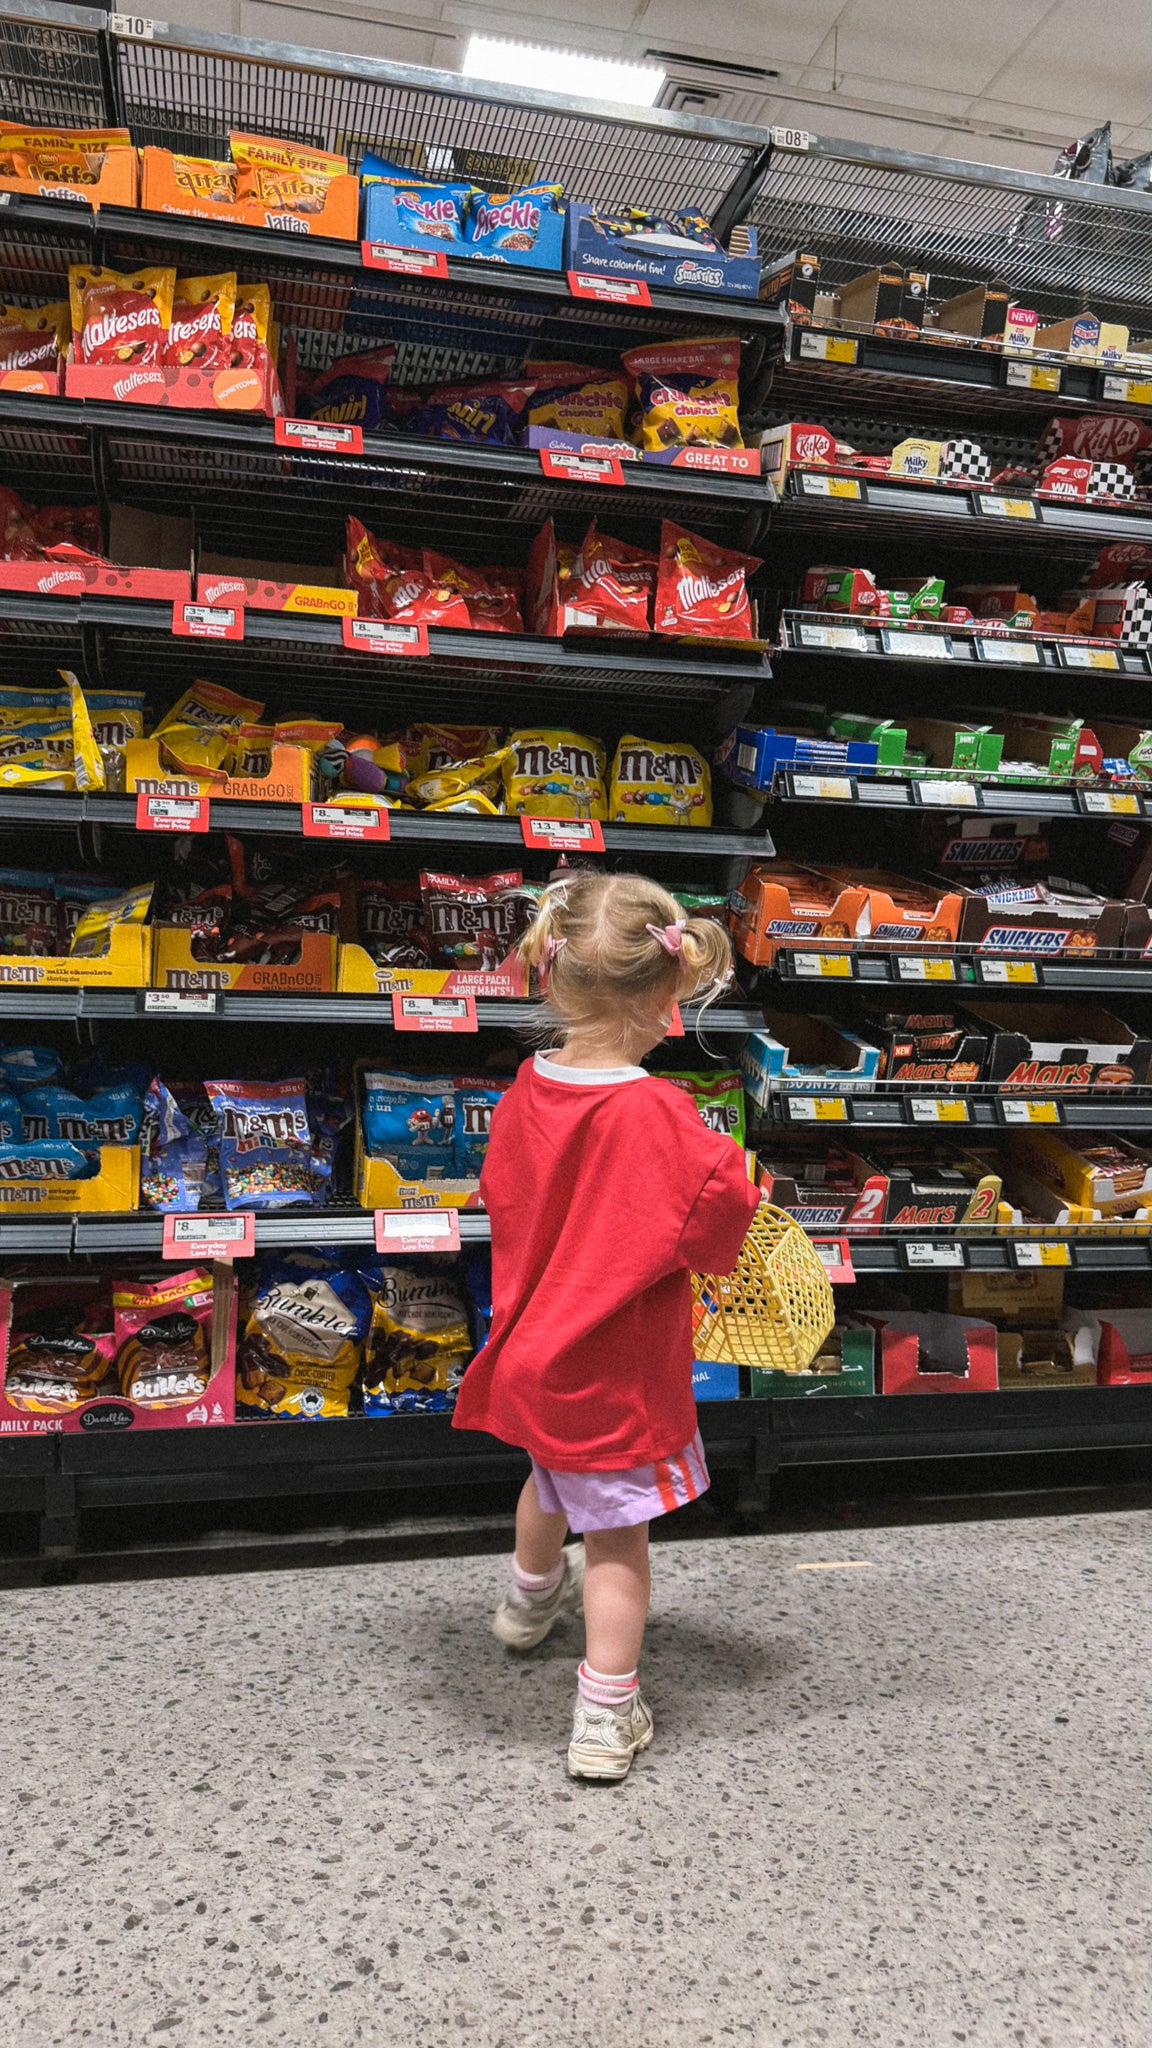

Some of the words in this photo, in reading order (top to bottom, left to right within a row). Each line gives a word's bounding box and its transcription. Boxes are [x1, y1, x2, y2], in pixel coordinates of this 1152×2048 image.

[125, 17, 144, 36] 10
[23, 137, 75, 150] FAMILY
[786, 130, 801, 146] 08
[247, 146, 296, 168] FAMILY
[298, 157, 328, 173] SIZE
[264, 212, 310, 234] Jaffas
[582, 253, 608, 268] Share
[1011, 311, 1036, 324] NEW
[82, 308, 160, 362] Maltesers
[1009, 332, 1031, 345] Milky
[1074, 326, 1099, 339] CRUNCH
[662, 355, 688, 364] SHARE
[688, 354, 705, 364] BAG
[113, 371, 165, 401] Maltesers
[217, 377, 259, 400] HONEYCOMB
[799, 435, 828, 457] KitKat
[685, 452, 728, 466] GREAT
[731, 456, 749, 468] TO
[904, 456, 929, 468] Milky
[907, 465, 922, 474] bar
[1051, 482, 1079, 494] WIN
[37, 570, 83, 593] Maltesers
[677, 567, 746, 611] Maltesers
[205, 581, 245, 604] Maltesers
[294, 596, 346, 611] GRABnGO
[189, 622, 227, 632] Everyday
[205, 629, 226, 637] Price
[370, 640, 404, 649] Everyday
[1056, 743, 1072, 751] MINT
[617, 749, 704, 786] m&m's
[135, 779, 199, 796] m&m's
[222, 782, 286, 798] GRABnGO
[153, 817, 192, 826] Everyday
[153, 822, 169, 830] Low
[170, 823, 191, 831] Price
[329, 825, 365, 833] Everyday
[945, 841, 1025, 861] SNICKERS
[427, 874, 458, 886] FAMILY
[988, 888, 1036, 904] SNICKERS
[430, 902, 516, 935] m&m's
[768, 921, 816, 935] SNICKERS
[877, 924, 921, 939] SNICKERS
[985, 929, 1067, 951] SNICKERS
[166, 970, 230, 989] m&m's
[252, 971, 314, 986] GRABnGO
[457, 975, 484, 985] LARGE
[485, 975, 511, 985] PACK!
[378, 980, 414, 993] m&m's
[419, 1017, 453, 1026] Everyday
[905, 1014, 954, 1029] Mars
[895, 1045, 911, 1056] NEW
[894, 1063, 947, 1080] Mars
[1001, 1061, 1094, 1090] Mars
[59, 1115, 136, 1141] m&m's
[223, 1108, 307, 1140] m&m's
[0, 1157, 75, 1179] m&m's
[401, 1195, 440, 1208] m&m's
[851, 1188, 884, 1219] 2
[970, 1188, 996, 1218] 2
[893, 1205, 957, 1224] Mars
[190, 1242, 228, 1251] Everyday
[401, 1237, 436, 1246] Everyday
[207, 1248, 227, 1256] Price
[160, 1284, 192, 1300] PACK
[255, 1287, 357, 1339] Bumbles
[5, 1376, 79, 1402] Bullets
[131, 1373, 207, 1399] Bullets
[33, 1419, 63, 1431] PACK
[114, 1412, 133, 1426] Lea
